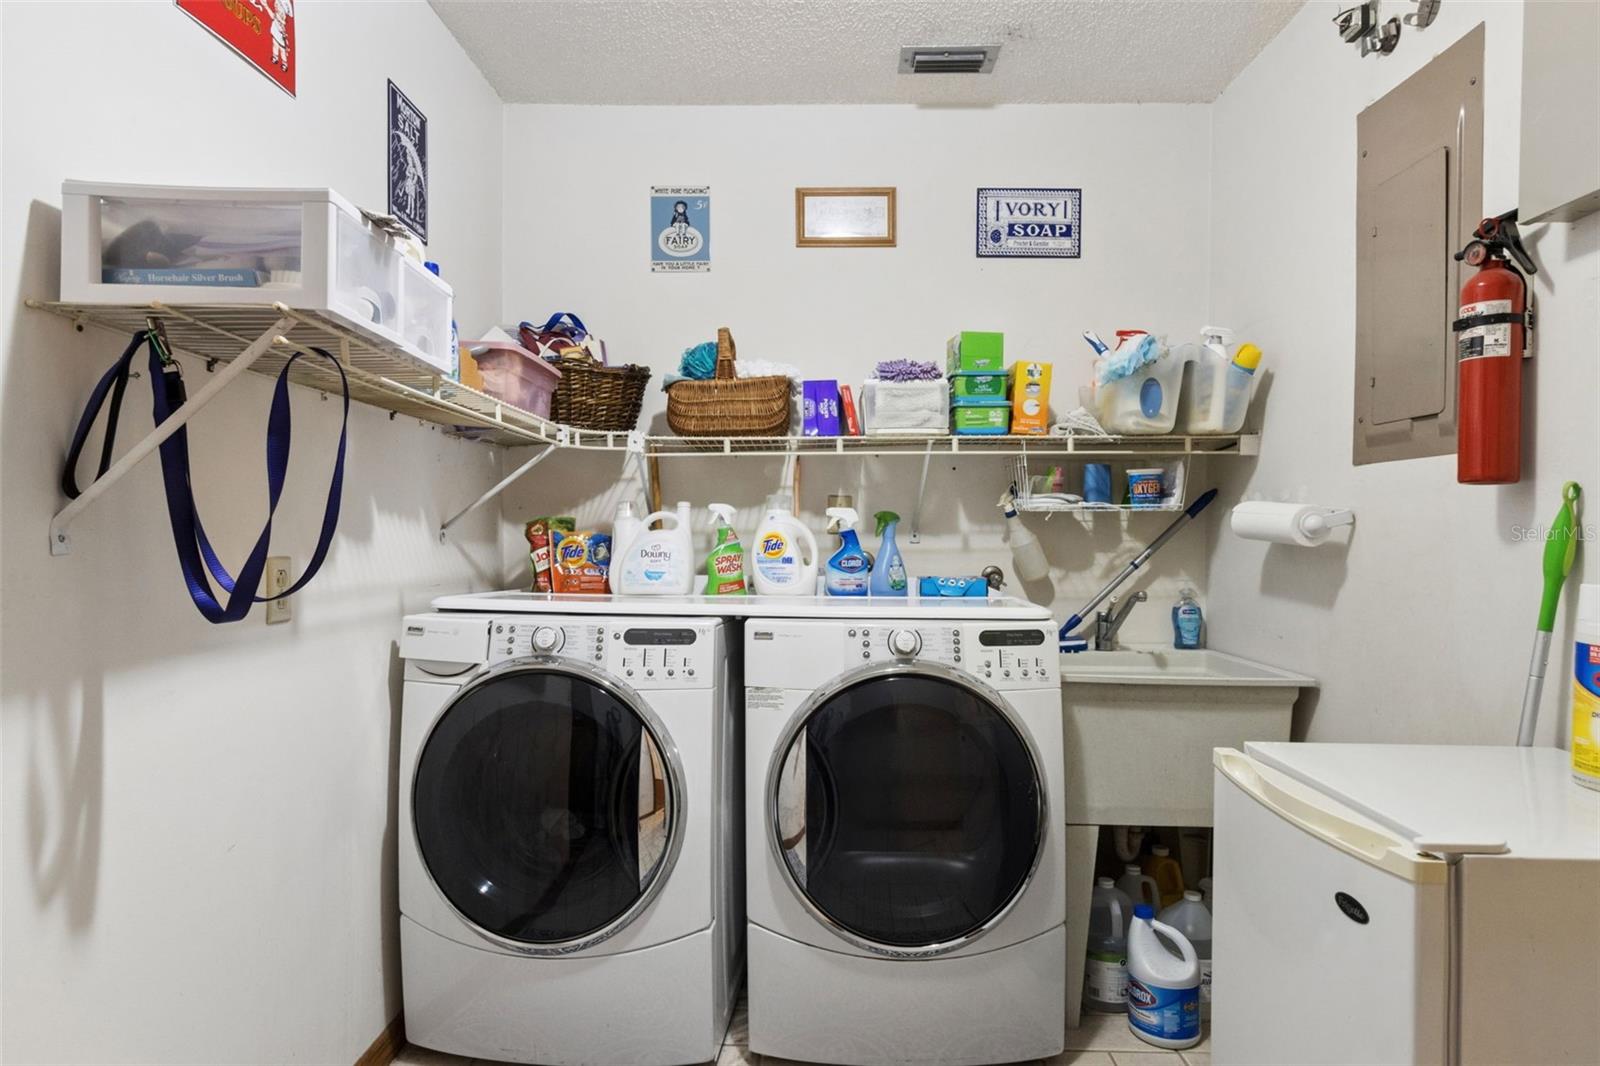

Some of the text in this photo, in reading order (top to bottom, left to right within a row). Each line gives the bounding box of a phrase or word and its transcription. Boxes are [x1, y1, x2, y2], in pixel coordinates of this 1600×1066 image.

[396, 93, 421, 129] MORTON
[397, 114, 420, 144] SALT
[995, 200, 1061, 222] IVORY
[1013, 224, 1067, 237] SOAP
[666, 236, 696, 245] FAIRY
[147, 273, 190, 282] Horsehair
[191, 273, 215, 282] Silver
[217, 273, 244, 282] Brush
[763, 539, 784, 554] Tide
[561, 544, 584, 563] Tide
[640, 549, 671, 561] Downy
[715, 554, 742, 566] SPRAY
[841, 559, 862, 568] CLOROX
[716, 564, 743, 574] WASH
